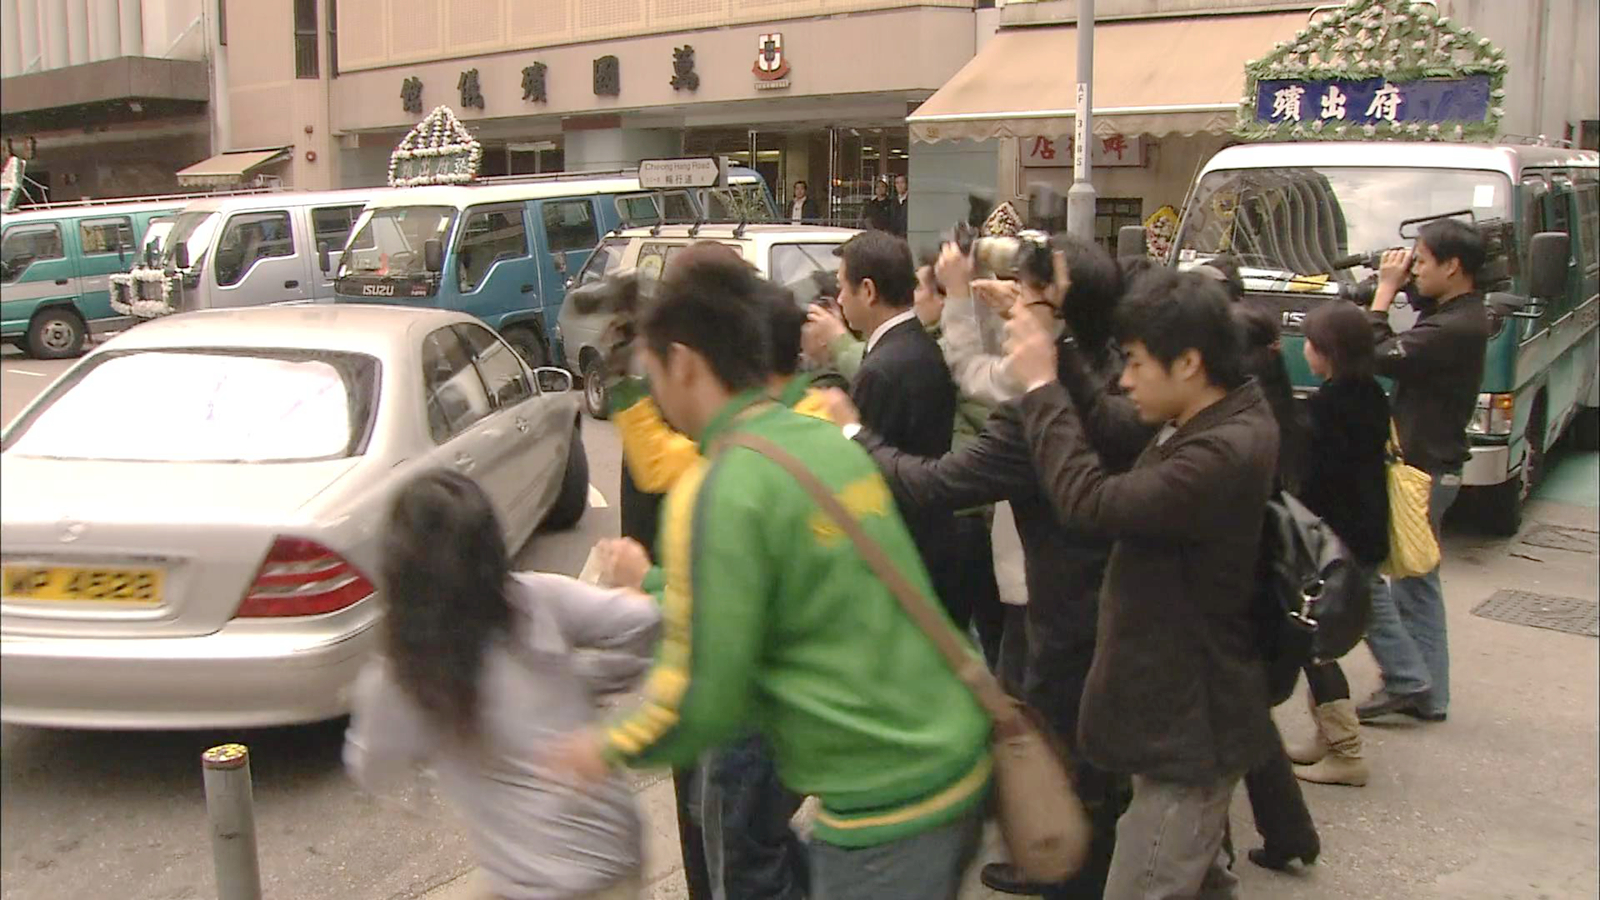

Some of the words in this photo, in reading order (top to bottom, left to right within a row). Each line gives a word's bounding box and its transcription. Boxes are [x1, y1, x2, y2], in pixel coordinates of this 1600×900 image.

[1077, 85, 1084, 104] AF
[645, 163, 673, 172] Cheong
[674, 162, 691, 171] Hang
[692, 161, 710, 170] Road
[362, 285, 395, 296] ISUZU
